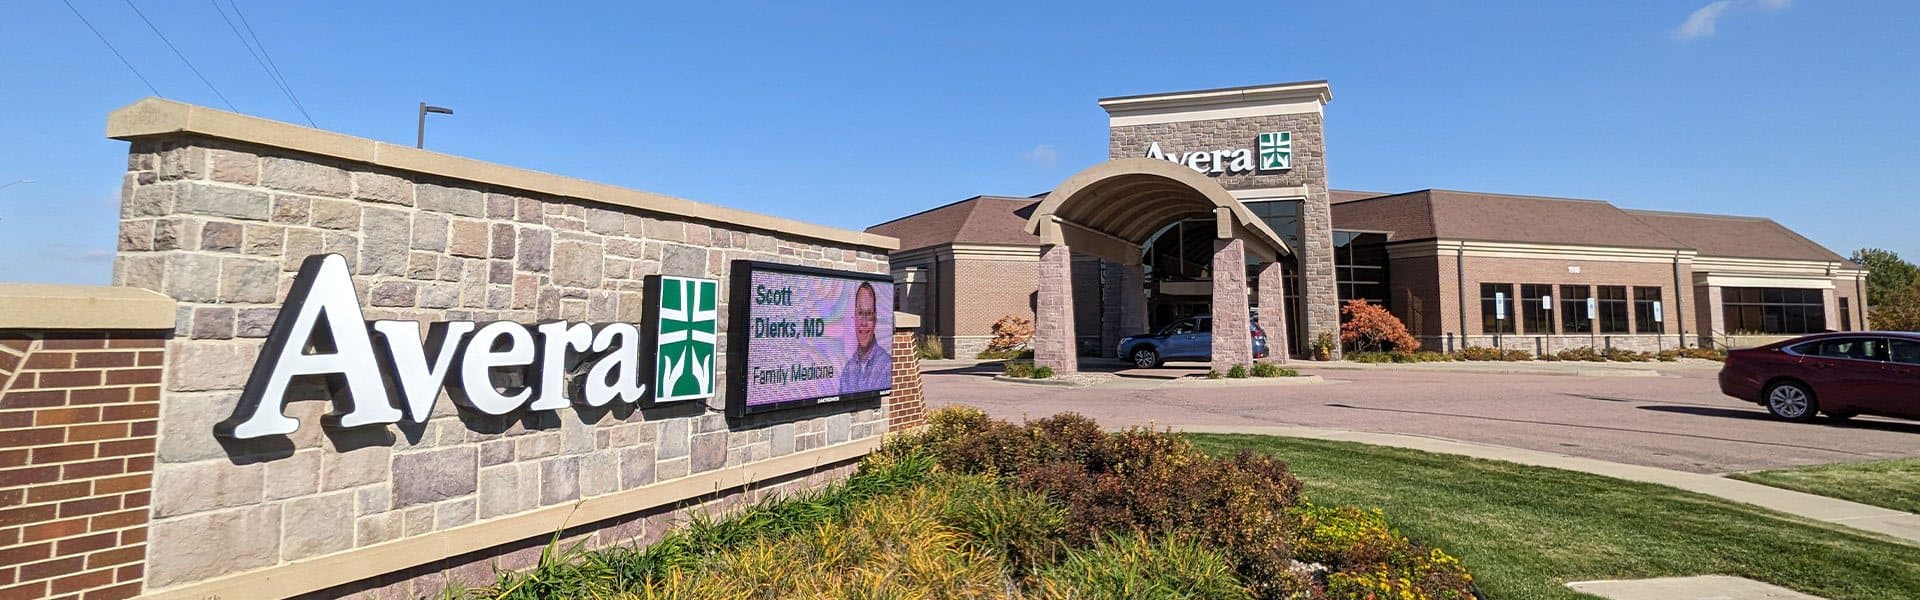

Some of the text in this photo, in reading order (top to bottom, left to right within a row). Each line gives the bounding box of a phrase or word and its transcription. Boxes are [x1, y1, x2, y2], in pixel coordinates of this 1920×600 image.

[1146, 141, 1255, 173] Avera
[756, 284, 792, 306] Scott
[803, 318, 825, 338] MD
[230, 253, 646, 439] Avera
[753, 362, 834, 385] Family Medicine
